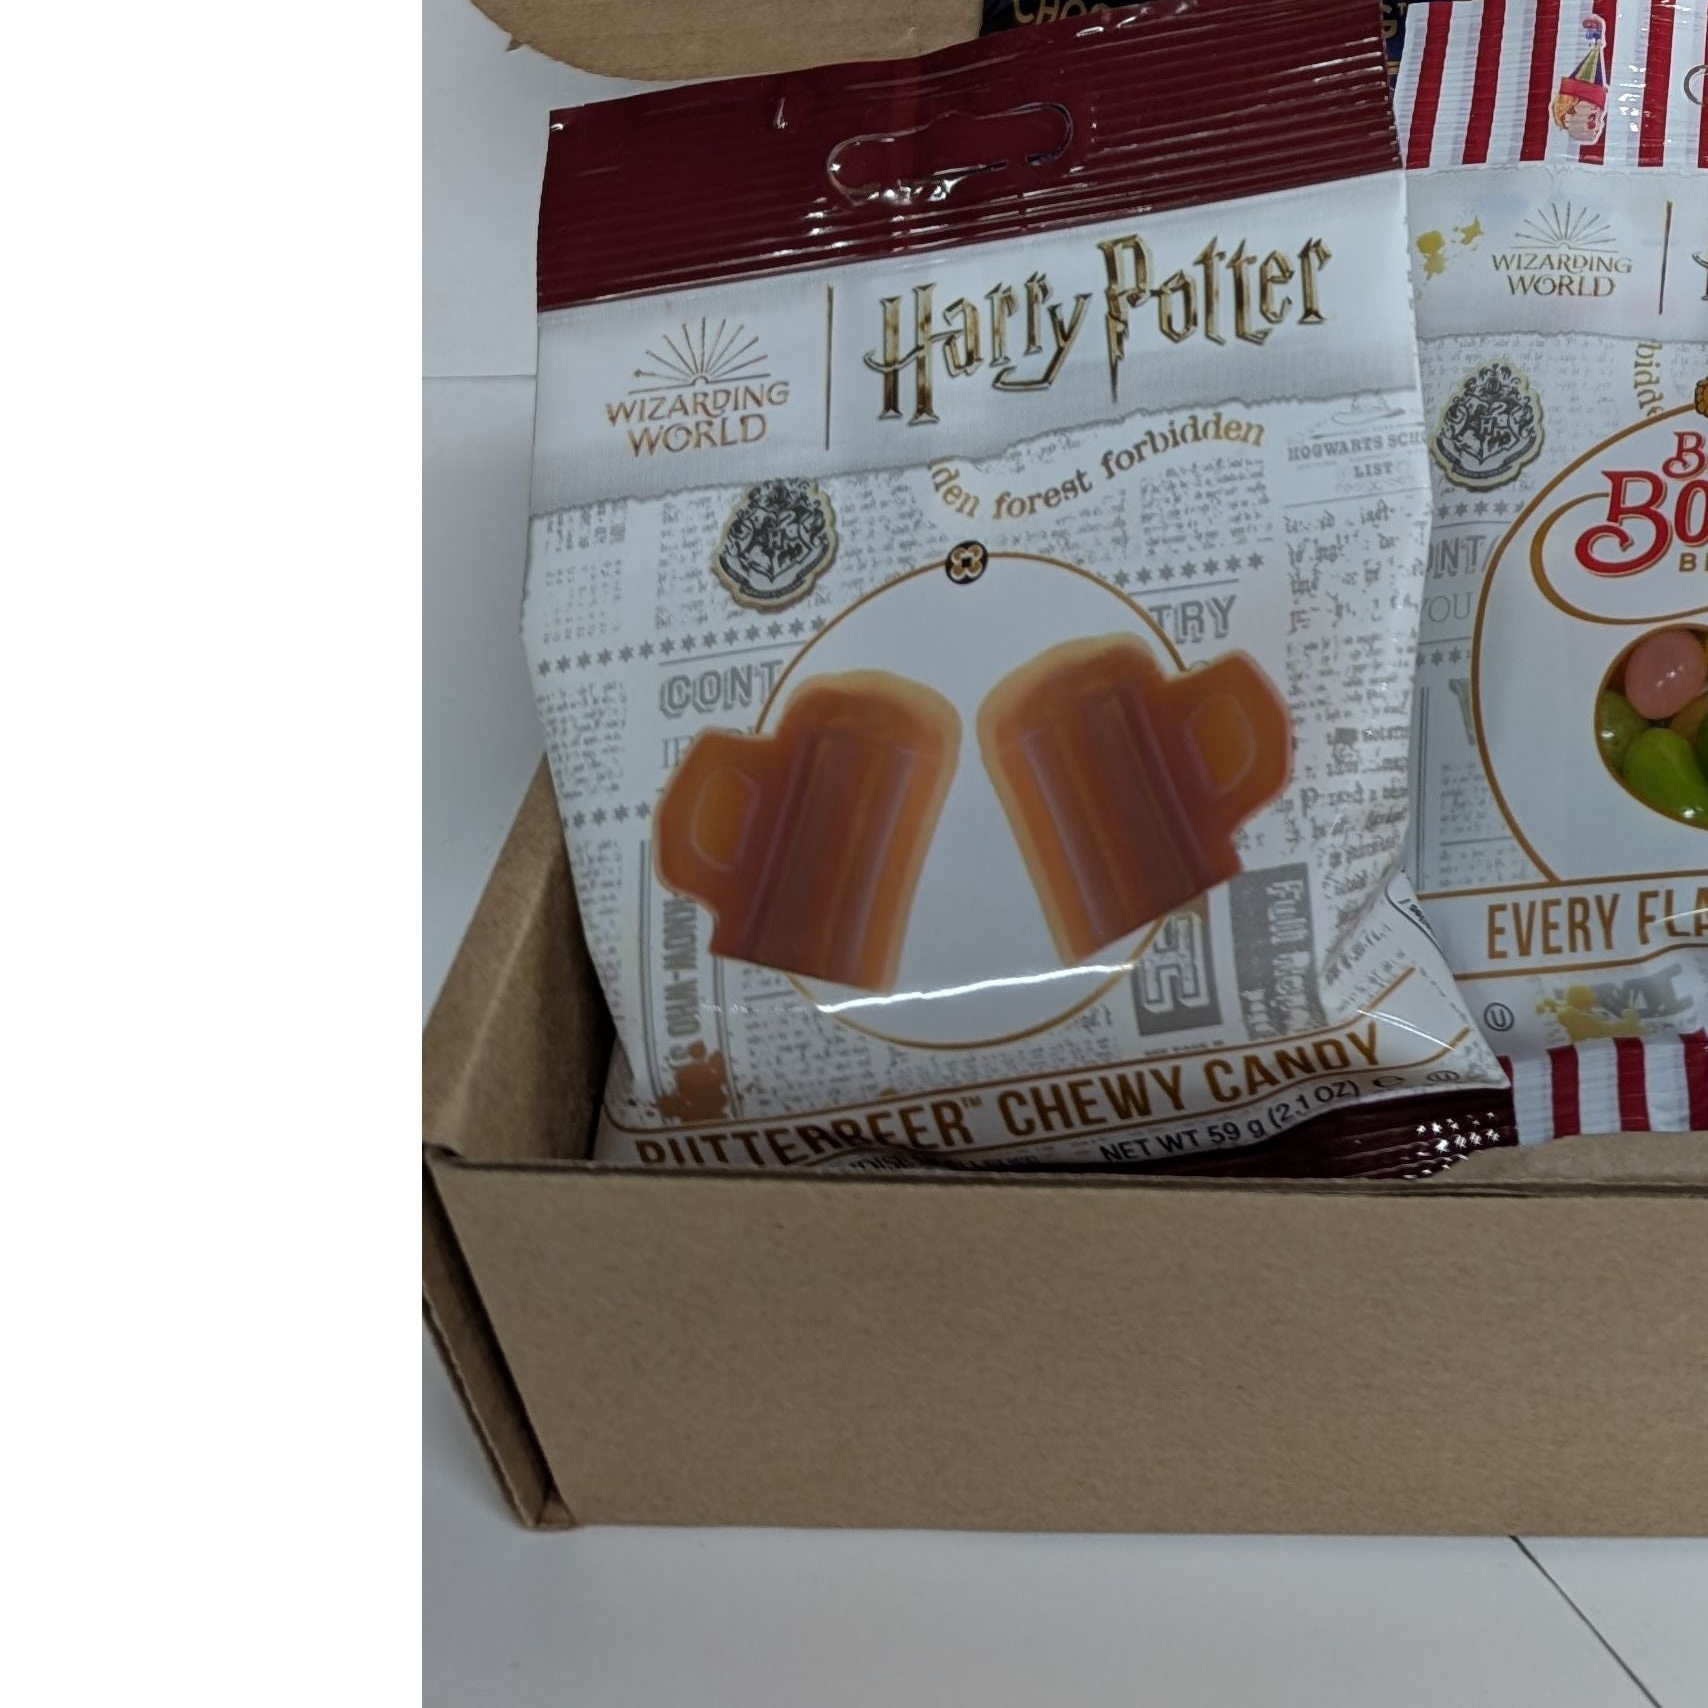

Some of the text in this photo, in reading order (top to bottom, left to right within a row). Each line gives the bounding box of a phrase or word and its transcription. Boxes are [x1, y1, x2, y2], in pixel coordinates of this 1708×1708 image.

[1491, 252, 1632, 275] WIZARDING
[1508, 274, 1616, 297] WORLD
[863, 234, 1331, 425] Harry Potter
[605, 381, 790, 427] WIZARDING
[627, 414, 768, 458] WORLD
[1288, 436, 1384, 462] HOGWARTS
[992, 469, 1093, 519] forest
[1101, 412, 1265, 480] forbidden
[1354, 461, 1394, 478] LIST
[1488, 893, 1620, 961] EVERY
[998, 1065, 1186, 1138] CHEWY
[1204, 1022, 1382, 1103] CANDY
[1101, 1138, 1152, 1163] NET
[1157, 1129, 1203, 1155] WT
[1207, 1121, 1241, 1146] 59
[1249, 1117, 1265, 1139] g
[1315, 1078, 1360, 1103] OZ)
